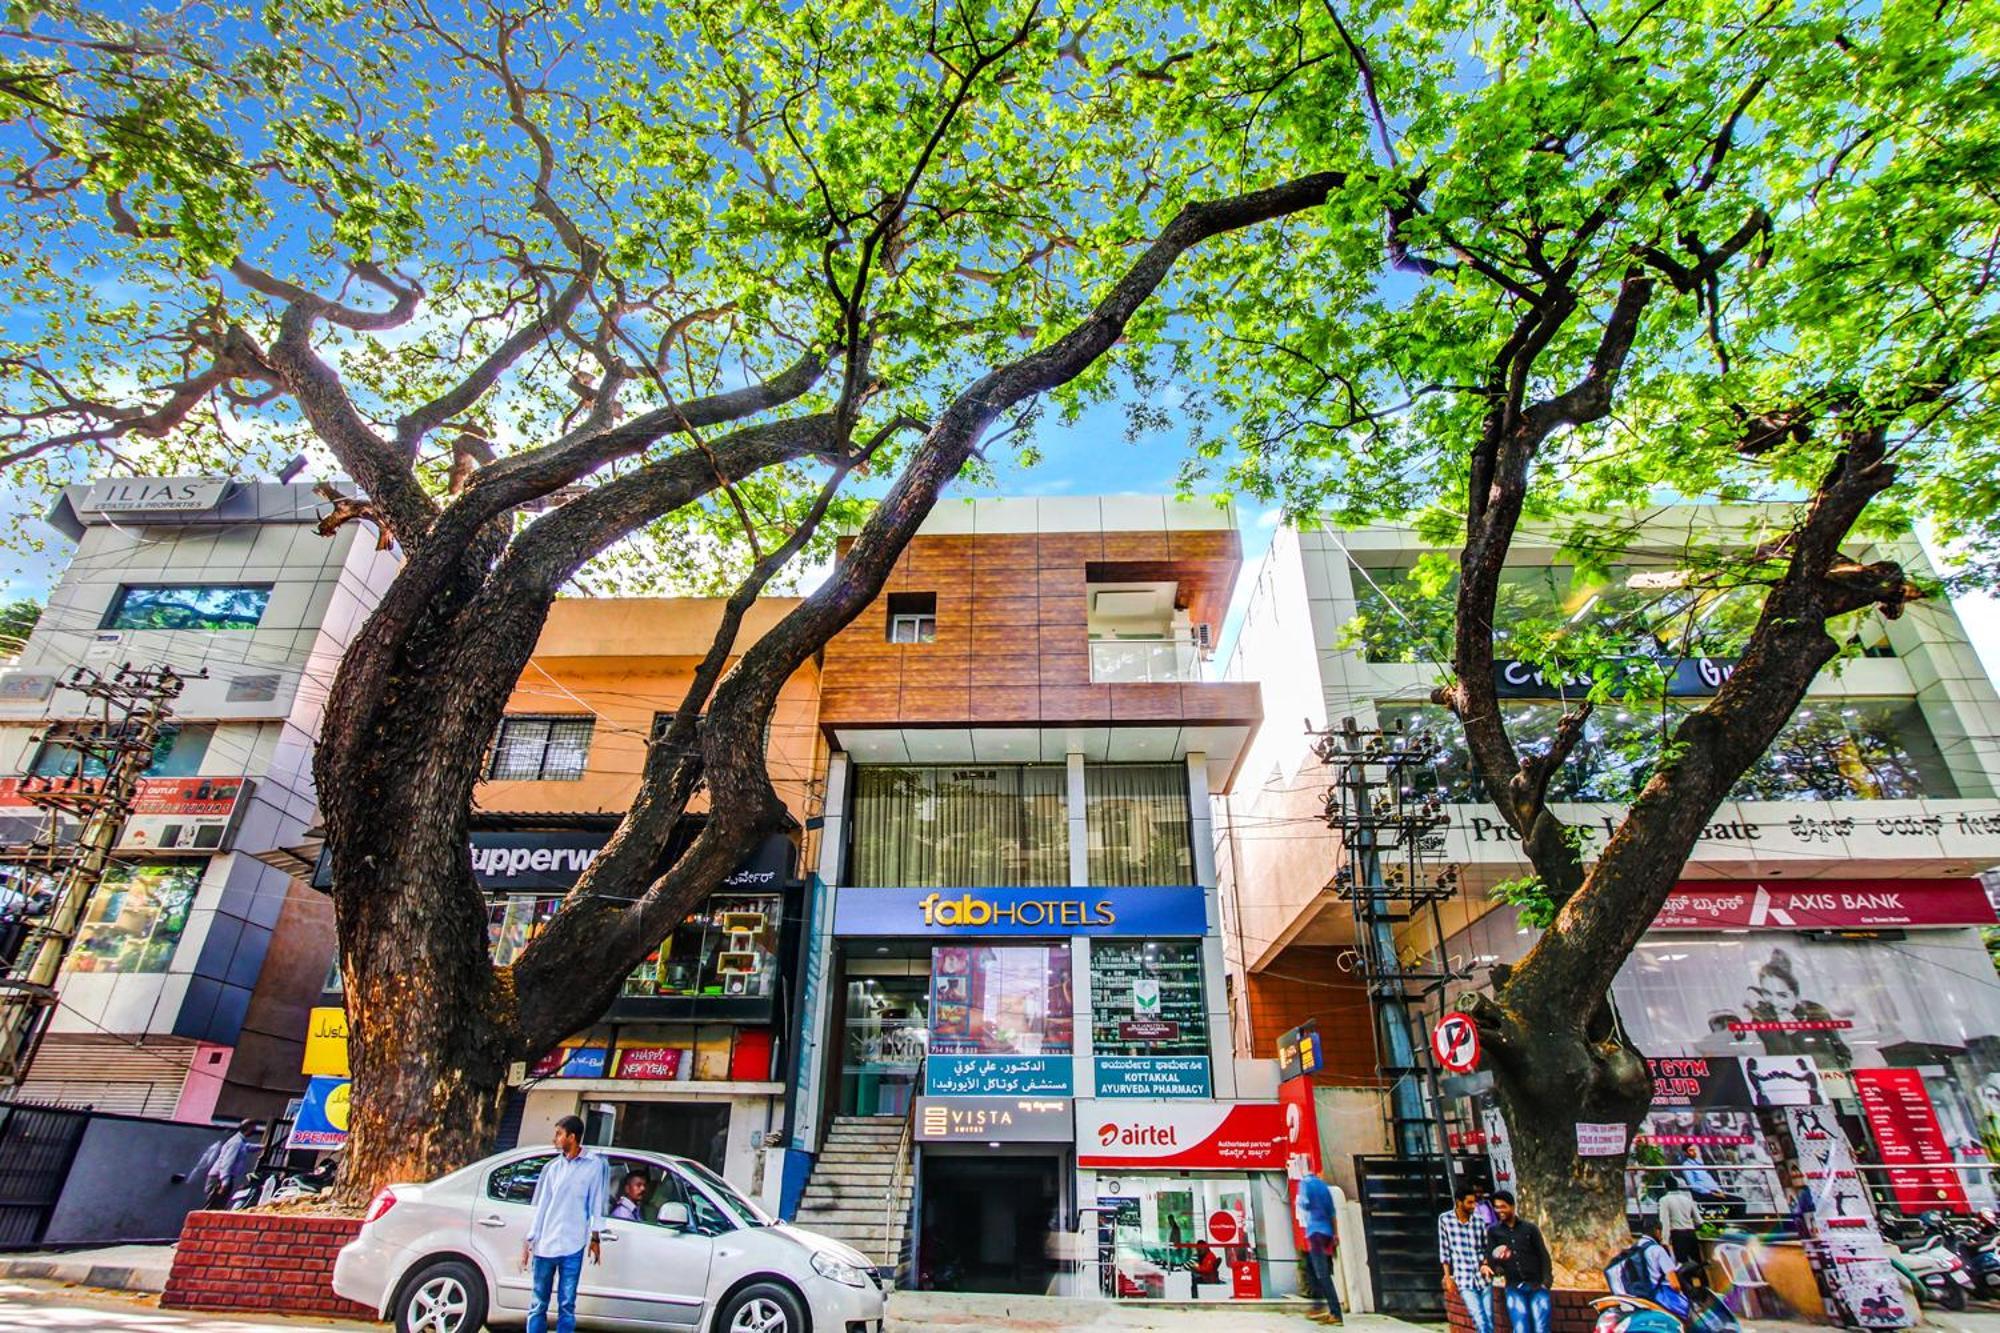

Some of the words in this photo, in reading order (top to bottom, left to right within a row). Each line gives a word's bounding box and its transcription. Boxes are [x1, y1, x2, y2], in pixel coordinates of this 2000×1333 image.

[106, 484, 200, 501] ILIAS
[145, 501, 202, 509] PROPERTIES
[468, 842, 600, 876] upperw
[1788, 894, 1837, 910] AXIS
[1841, 893, 1906, 910] BANK
[1660, 1060, 1710, 1077] GYM
[1124, 1073, 1180, 1082] KOTTAKKAL
[1101, 1085, 1150, 1094] AYURVEDA
[1153, 1085, 1204, 1094] PHARMACY
[952, 1111, 1012, 1125] VISTA
[1121, 1123, 1177, 1146] airtel
